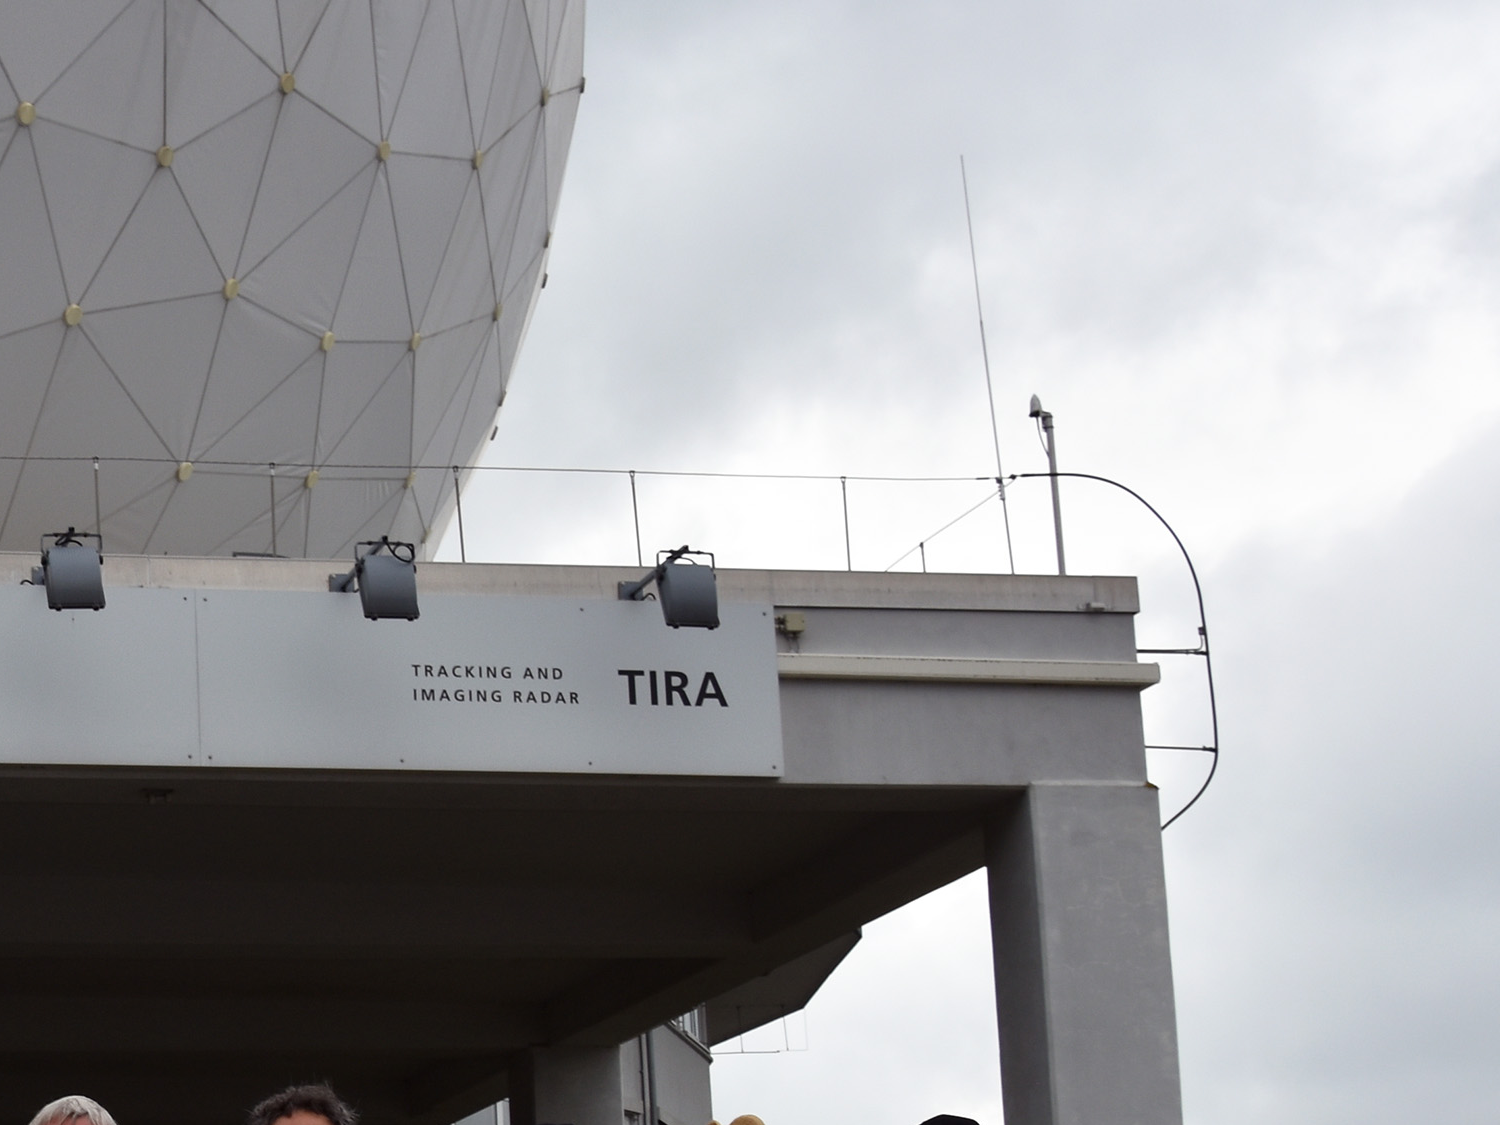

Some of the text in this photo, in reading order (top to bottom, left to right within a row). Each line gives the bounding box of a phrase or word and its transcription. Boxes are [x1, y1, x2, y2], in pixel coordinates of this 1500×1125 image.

[411, 664, 564, 680] TRACKING AND
[412, 688, 580, 704] IMAGING RADAR
[617, 669, 729, 708] TIRA
